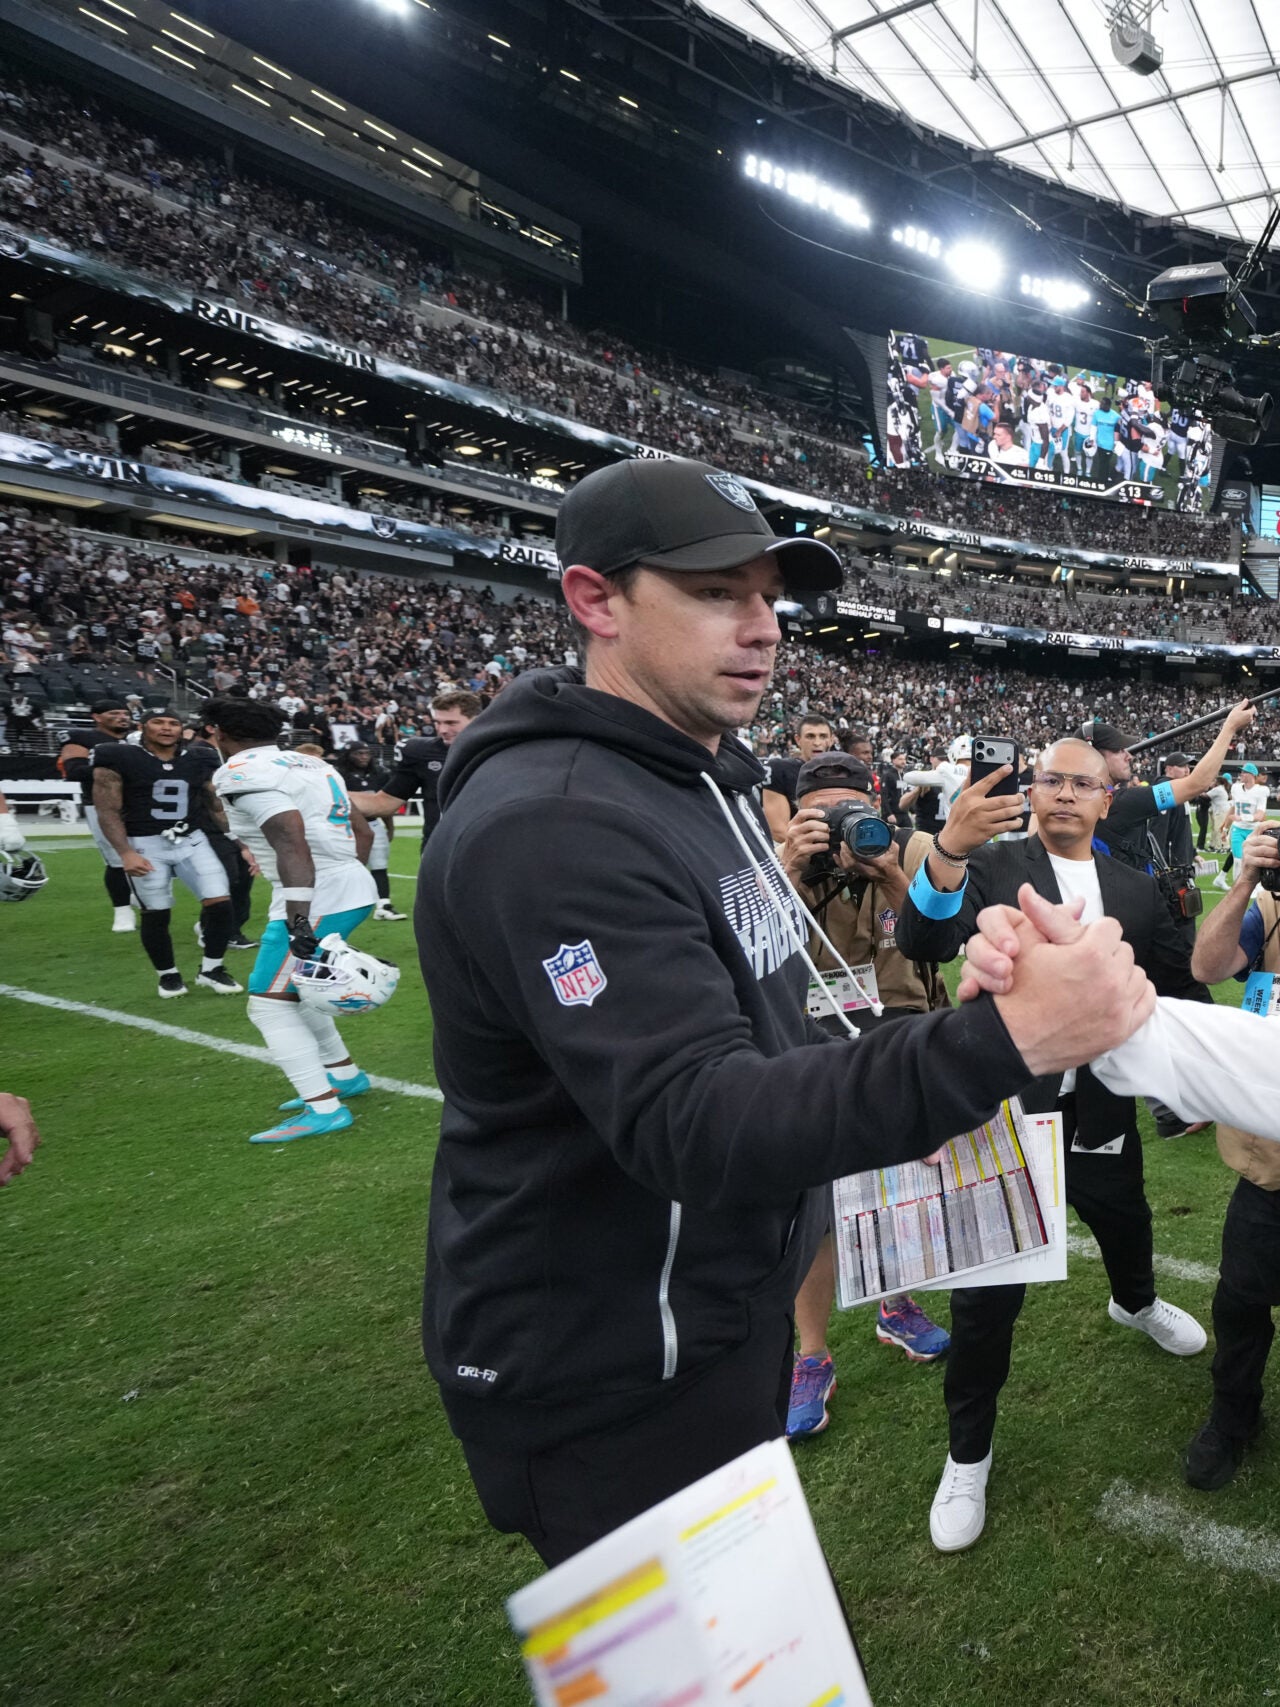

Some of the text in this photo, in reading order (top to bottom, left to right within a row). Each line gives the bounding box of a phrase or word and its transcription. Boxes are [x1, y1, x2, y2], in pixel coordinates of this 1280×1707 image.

[971, 461, 986, 475] 27
[1034, 472, 1055, 483] 0:15
[1063, 476, 1076, 486] 20
[1128, 486, 1141, 498] 13
[848, 609, 873, 619] BEHALF
[873, 612, 883, 620] OF
[857, 603, 888, 615] DOLPHINS
[151, 779, 189, 821] 9
[556, 965, 601, 1000] NFL
